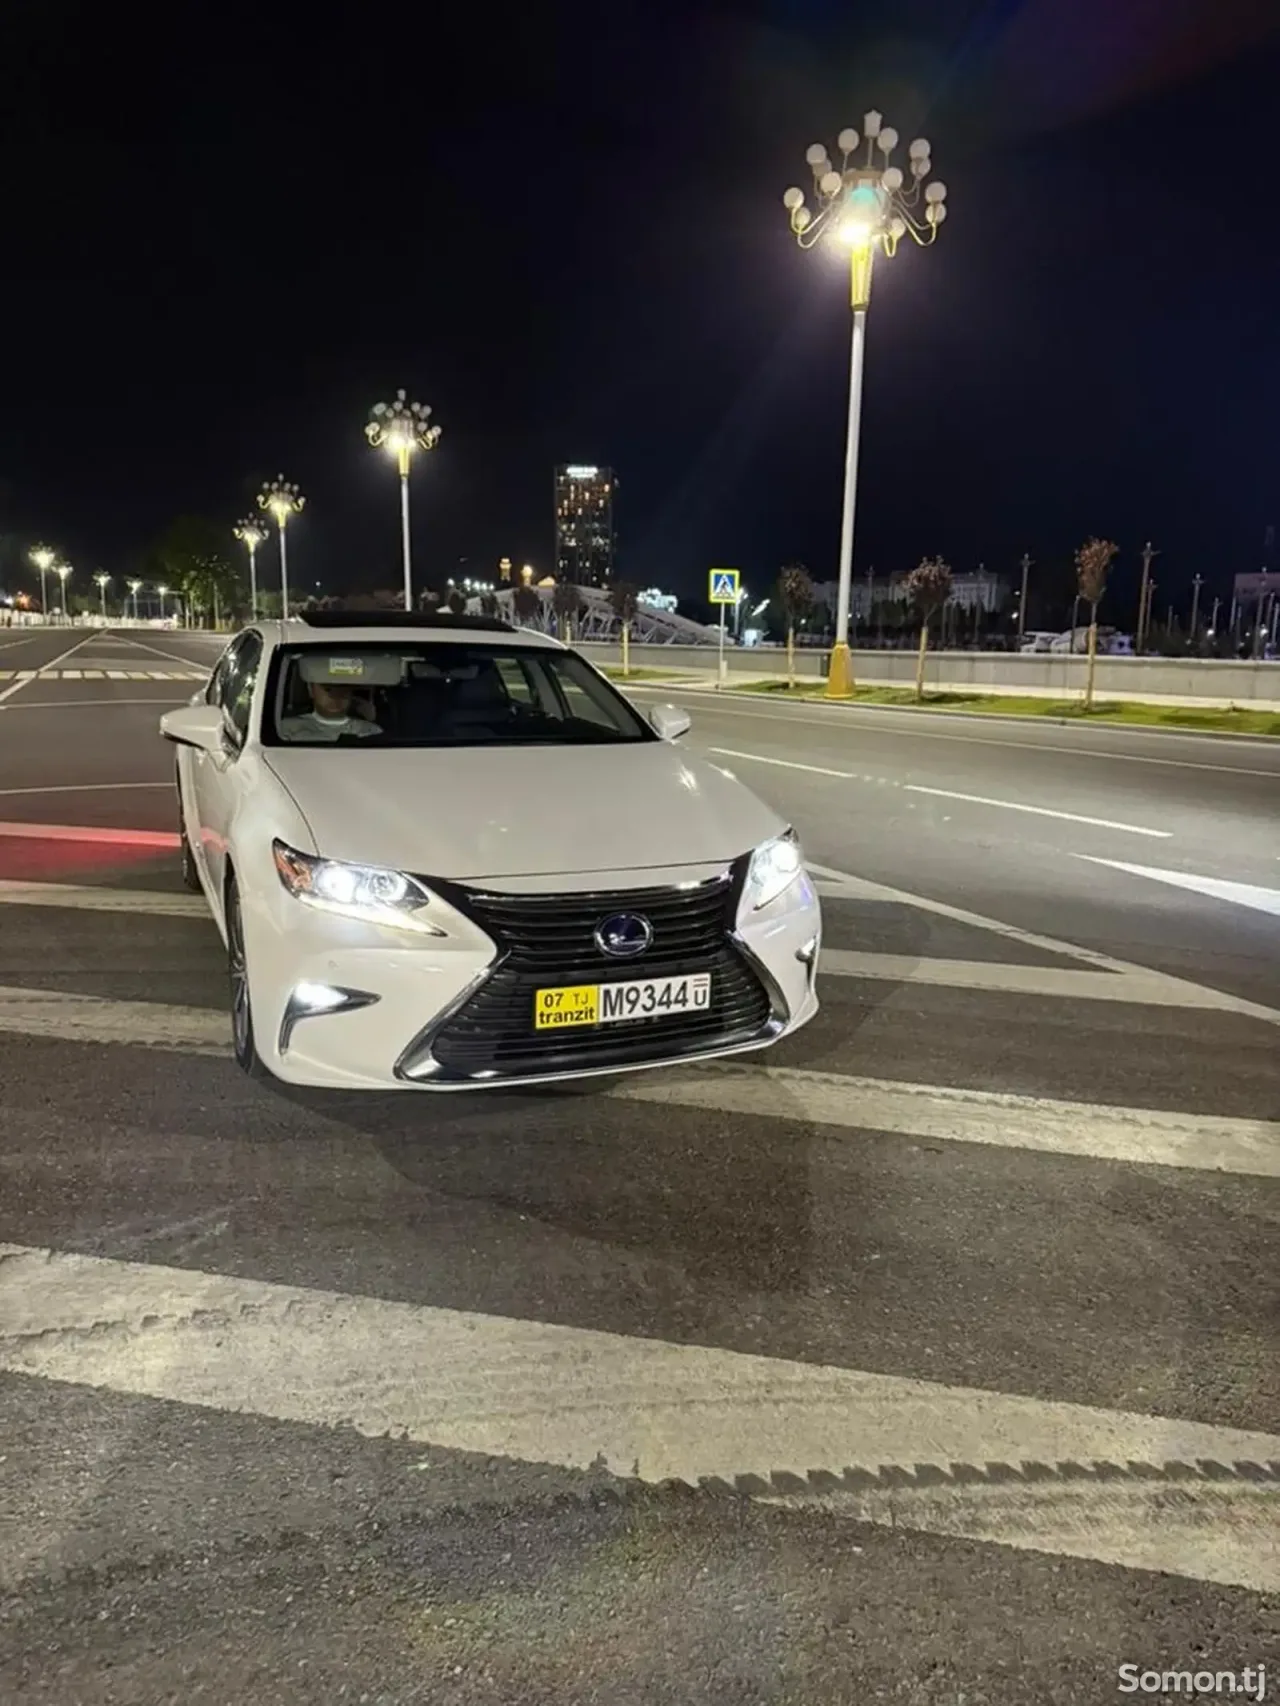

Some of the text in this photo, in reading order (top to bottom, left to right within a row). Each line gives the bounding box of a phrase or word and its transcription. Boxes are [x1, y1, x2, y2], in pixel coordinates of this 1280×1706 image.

[543, 992, 589, 1008] 07 TJ
[602, 980, 689, 1018] M9344
[539, 1006, 595, 1025] tranzit
